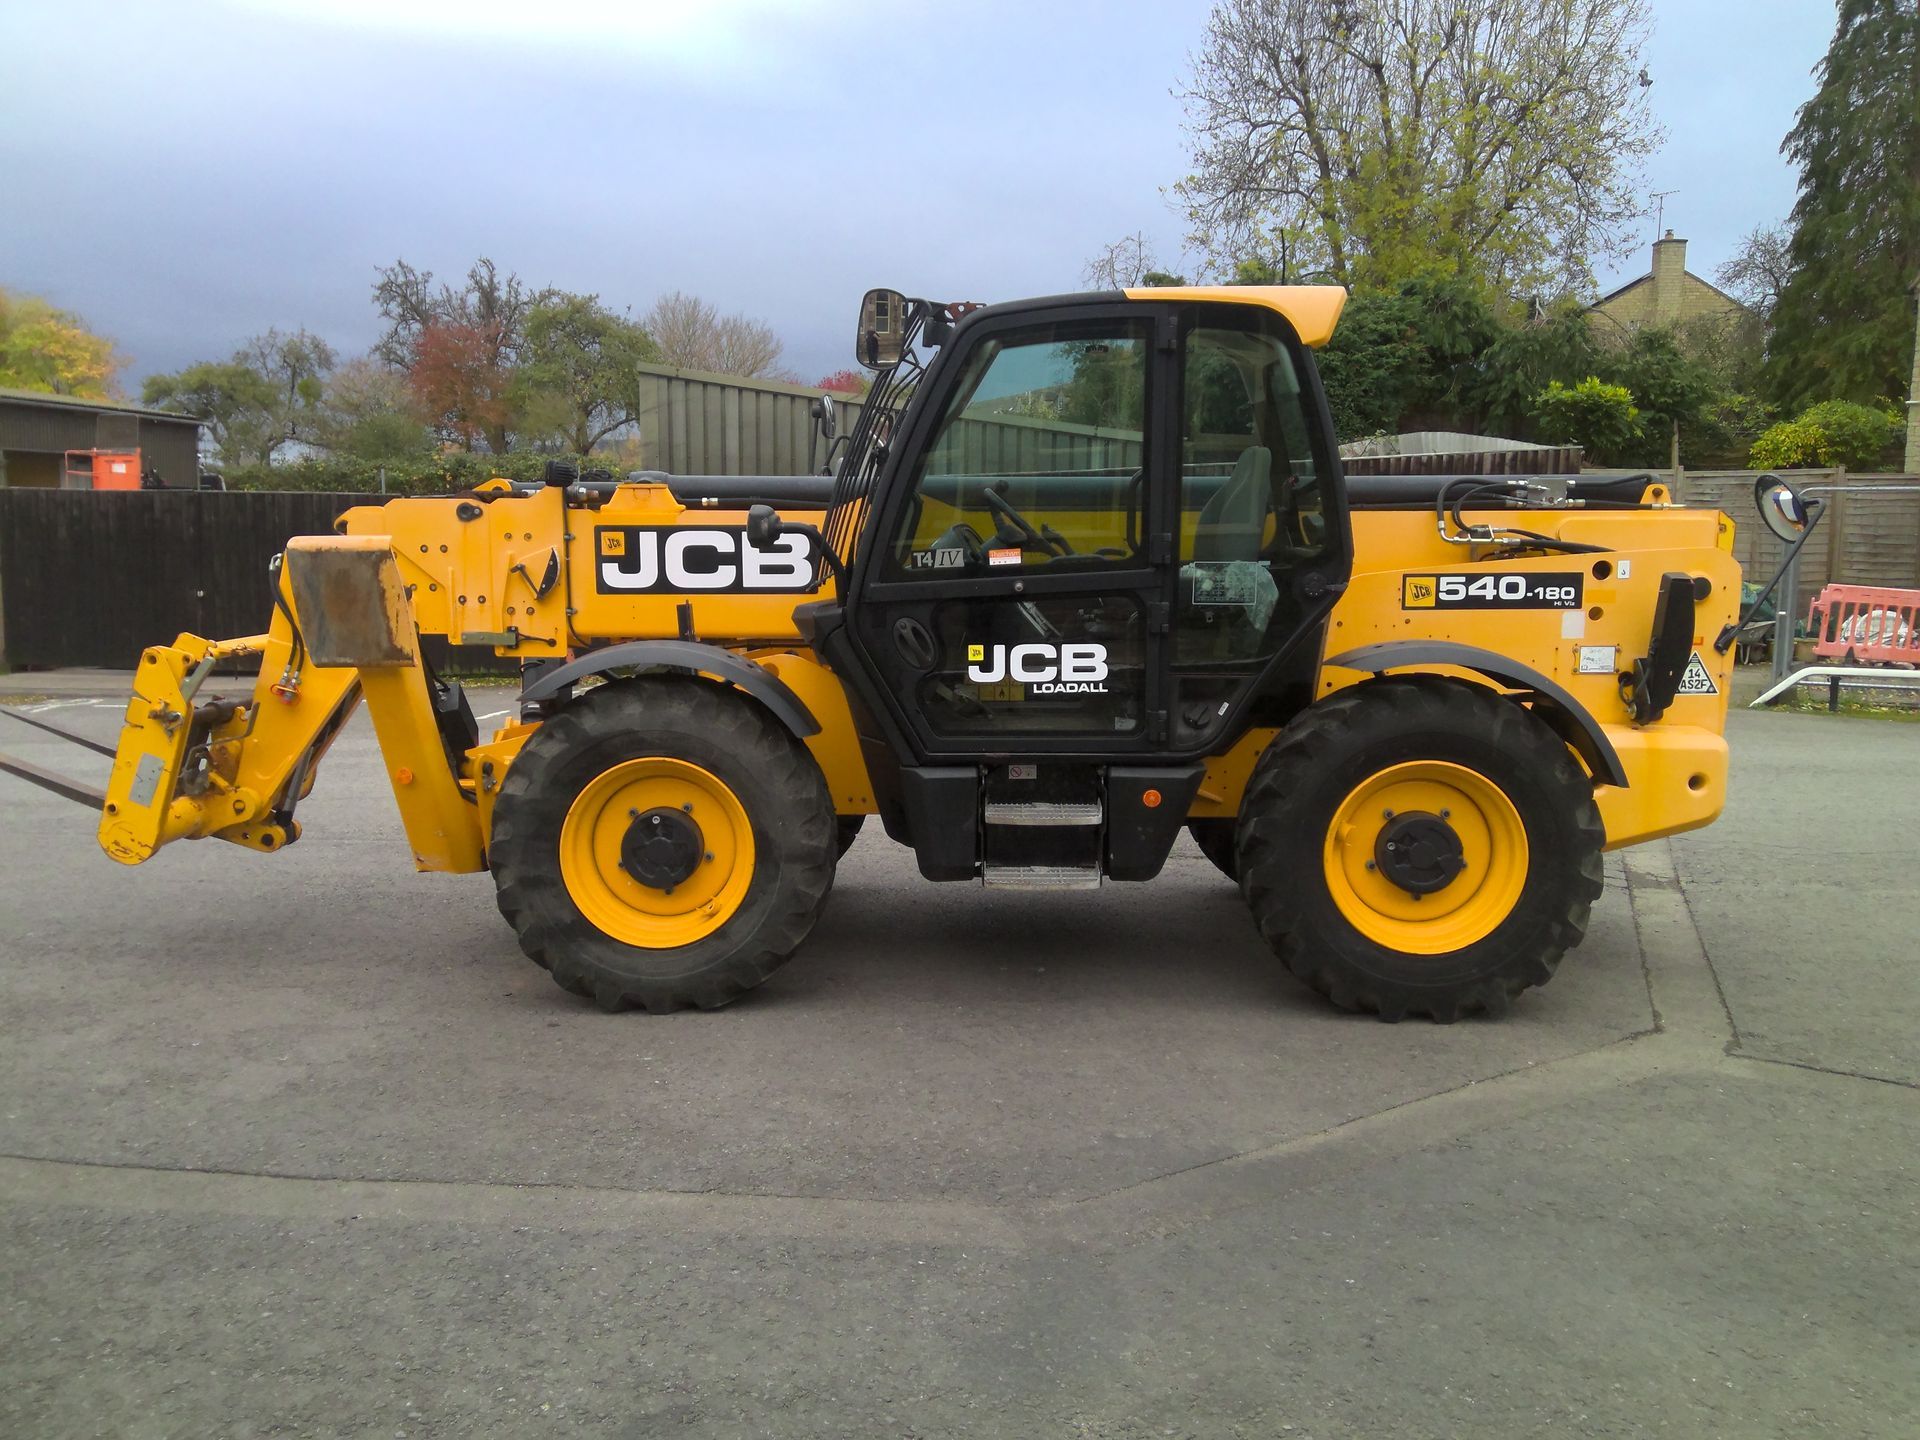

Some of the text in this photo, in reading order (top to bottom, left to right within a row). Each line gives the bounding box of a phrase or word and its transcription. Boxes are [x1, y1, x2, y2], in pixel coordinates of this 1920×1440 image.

[607, 537, 621, 549] JCB
[602, 530, 813, 588] JCB
[913, 550, 961, 568] T4 IV
[1413, 584, 1431, 599] JCB
[1438, 575, 1576, 601] 540-180
[968, 643, 1109, 683] JCB
[1688, 668, 1701, 679] 14
[1033, 682, 1109, 694] LOADALL
[1680, 679, 1708, 690] AS2F
